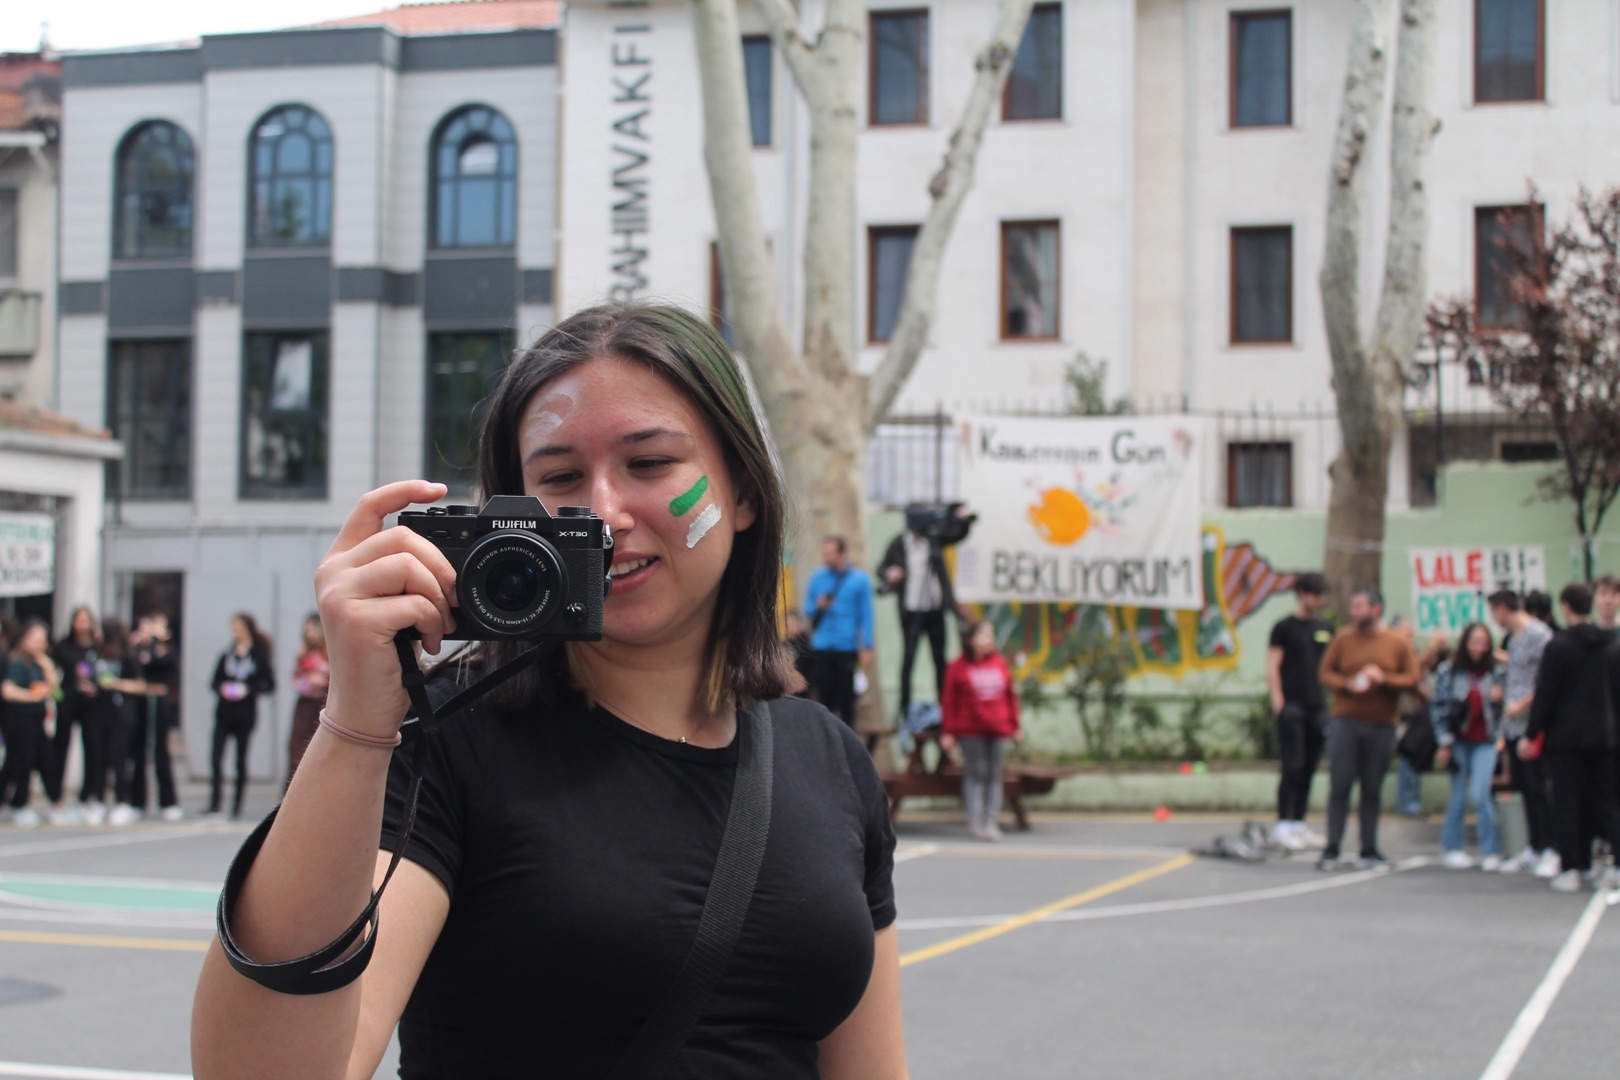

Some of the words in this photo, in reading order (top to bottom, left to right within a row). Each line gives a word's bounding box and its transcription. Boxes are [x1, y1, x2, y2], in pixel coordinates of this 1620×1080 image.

[492, 520, 536, 529] FUJIFILM
[477, 549, 498, 570] FUJINON
[500, 546, 536, 559] ASPHERICAL
[535, 558, 547, 572] LENS
[1414, 550, 1484, 588] LALE
